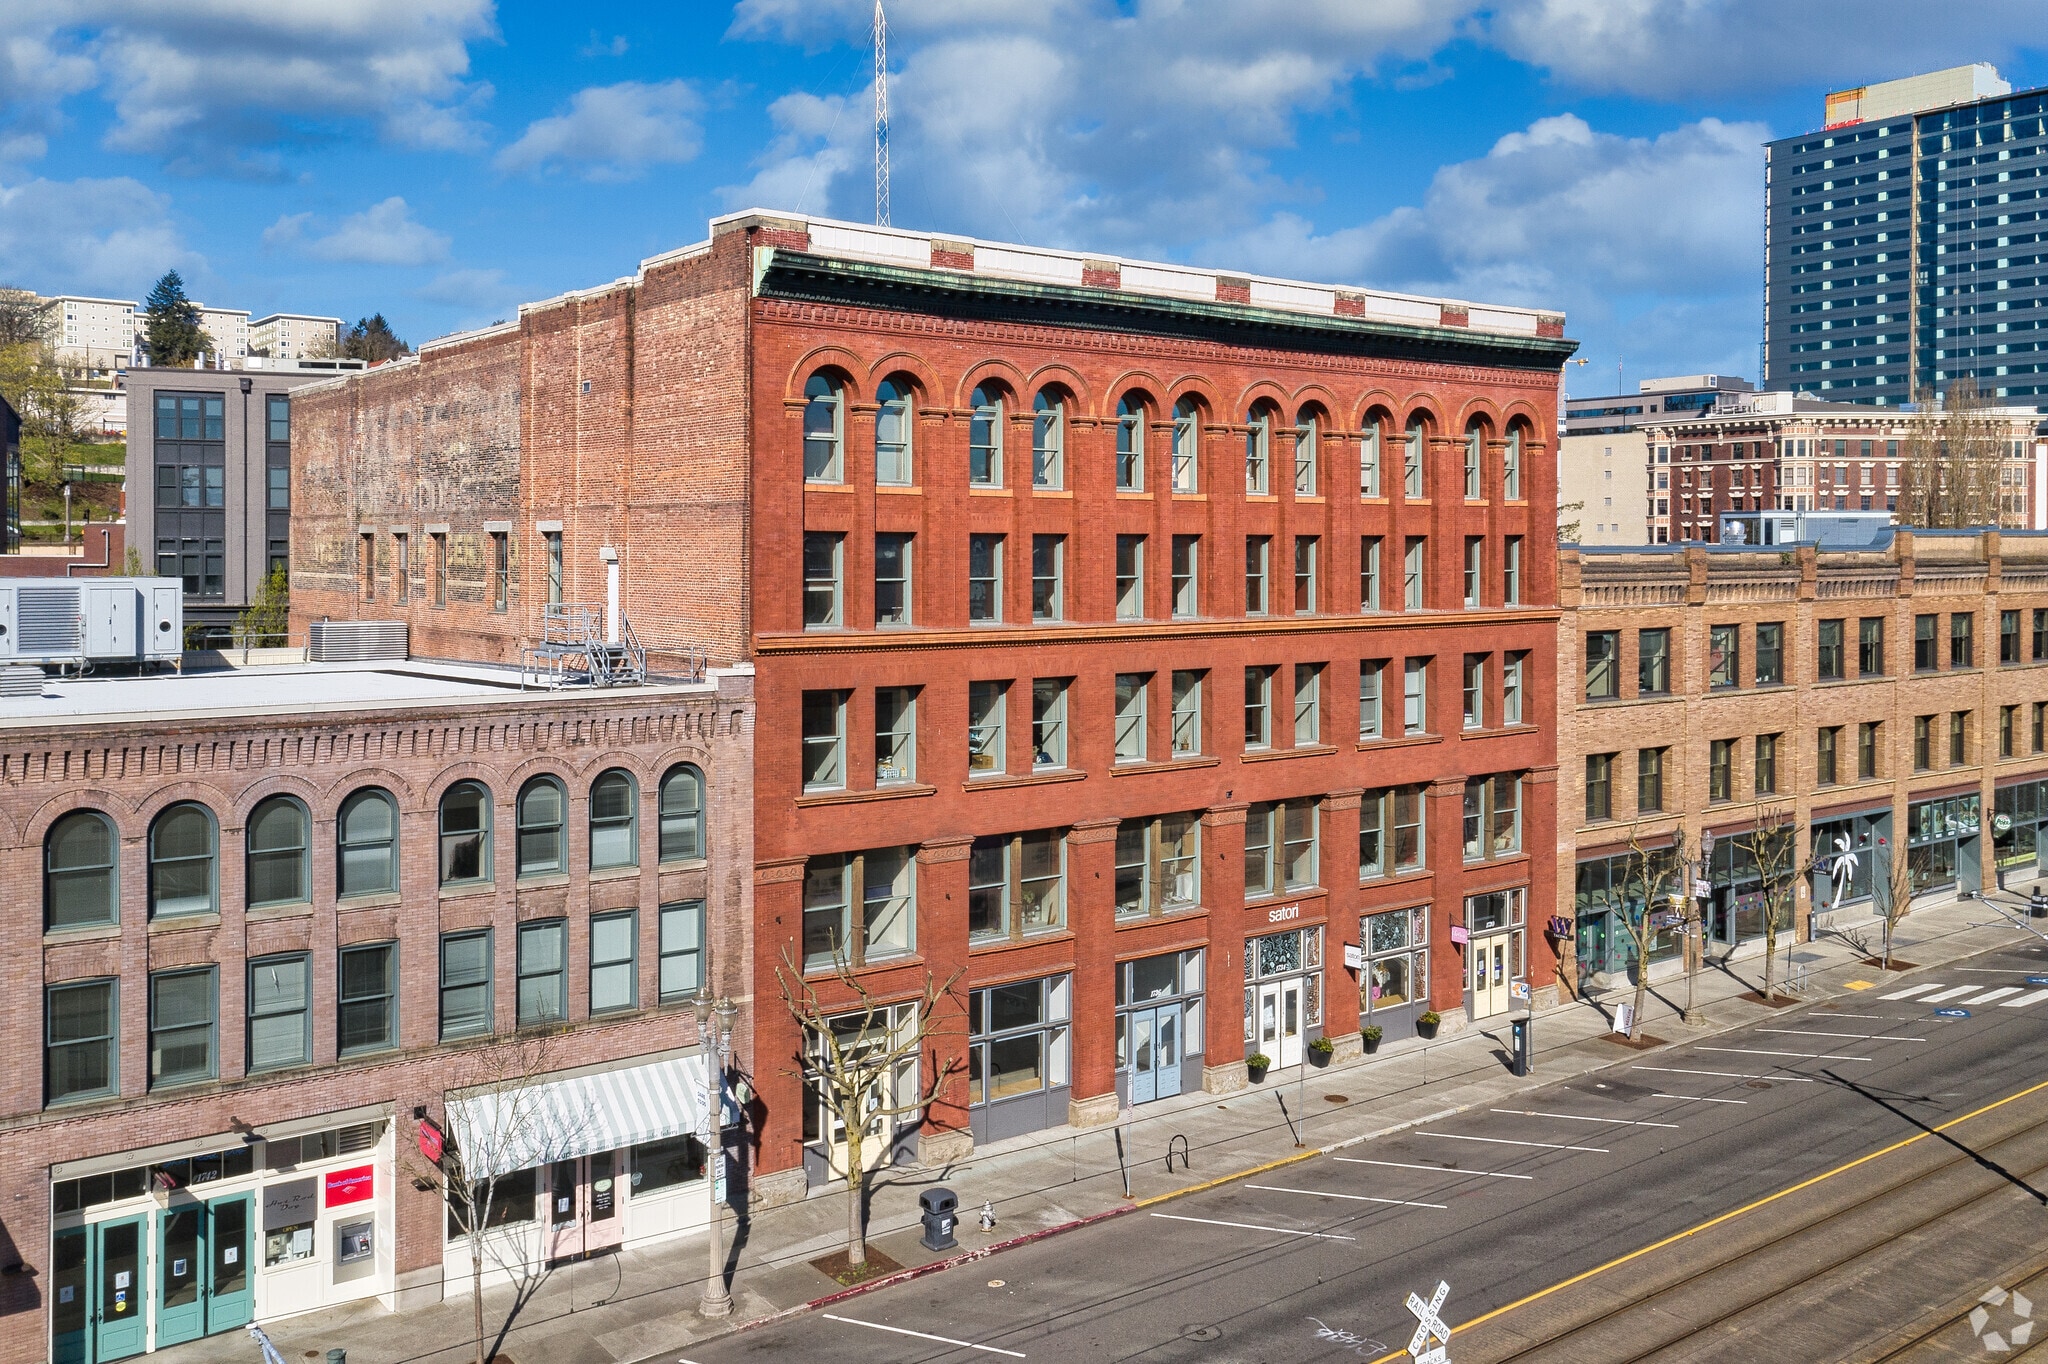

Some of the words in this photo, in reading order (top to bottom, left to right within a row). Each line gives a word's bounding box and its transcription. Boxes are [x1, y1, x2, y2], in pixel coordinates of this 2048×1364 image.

[1268, 903, 1299, 923] satori
[1551, 915, 1574, 935] W
[1553, 932, 1568, 940] TACOMA
[195, 1170, 218, 1183] 1742
[327, 1180, 342, 1189] Bank
[348, 1175, 372, 1185] America
[293, 1193, 314, 1201] Rod
[282, 1225, 298, 1233] OPEN
[1408, 1296, 1425, 1318] RAIL
[1431, 1319, 1449, 1340] ROAD
[1412, 1287, 1446, 1350] CROSSING
